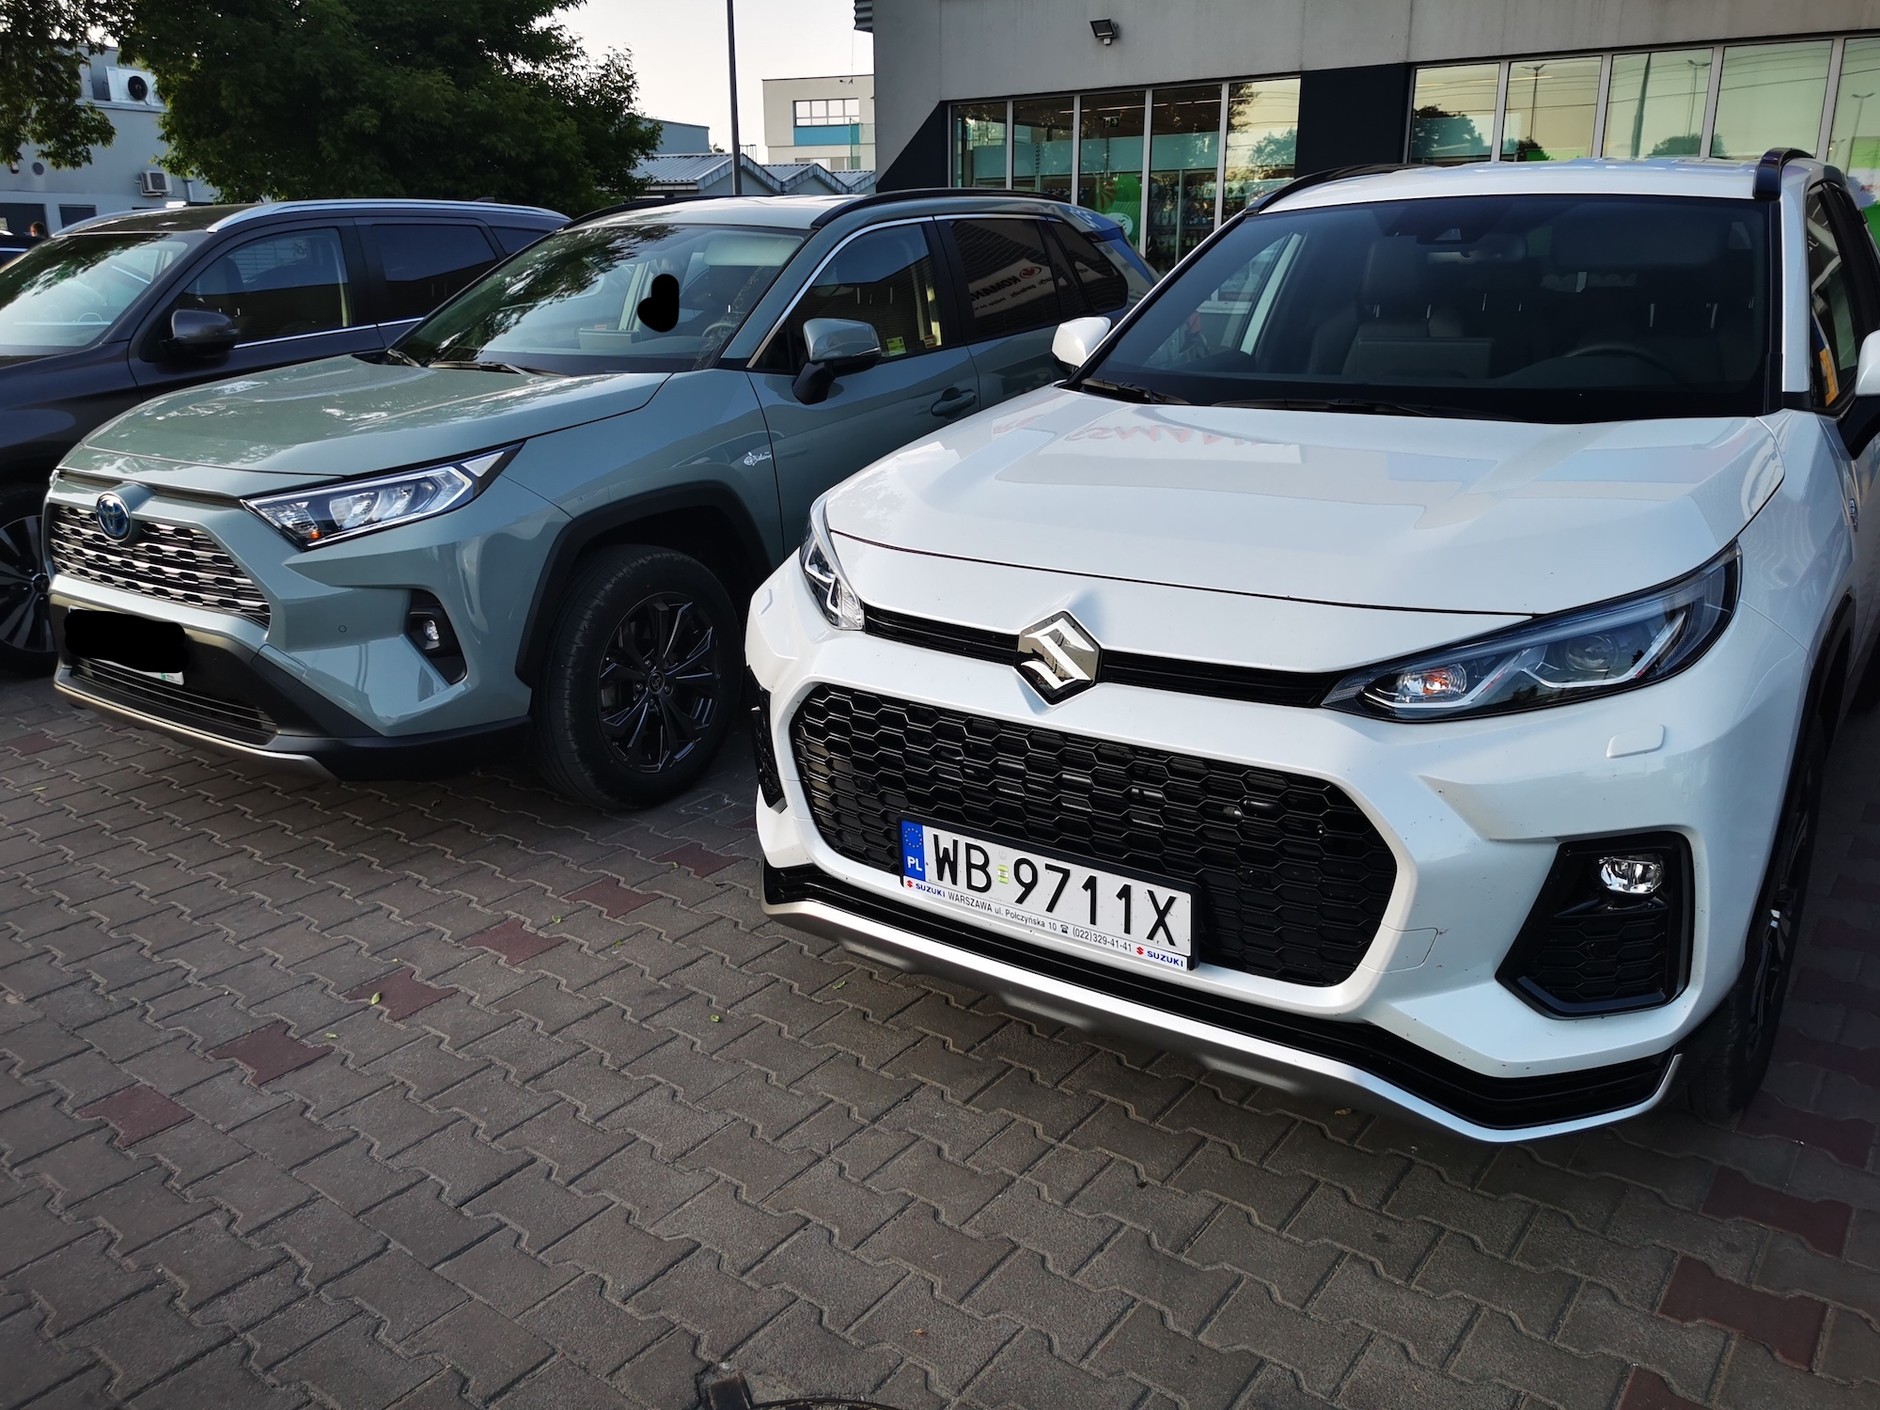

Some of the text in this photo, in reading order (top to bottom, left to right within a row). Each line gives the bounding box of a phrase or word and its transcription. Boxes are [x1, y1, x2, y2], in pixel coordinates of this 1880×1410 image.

[907, 856, 923, 872] PL
[933, 833, 1177, 947] WB 9711X
[915, 882, 946, 898] SUZUKI
[948, 892, 993, 913] WARSZAWA
[994, 906, 1004, 916] ul.
[1048, 922, 1057, 931] 10
[1072, 926, 1132, 952] (022)329-41-41
[1147, 950, 1184, 967] SUZUKI
